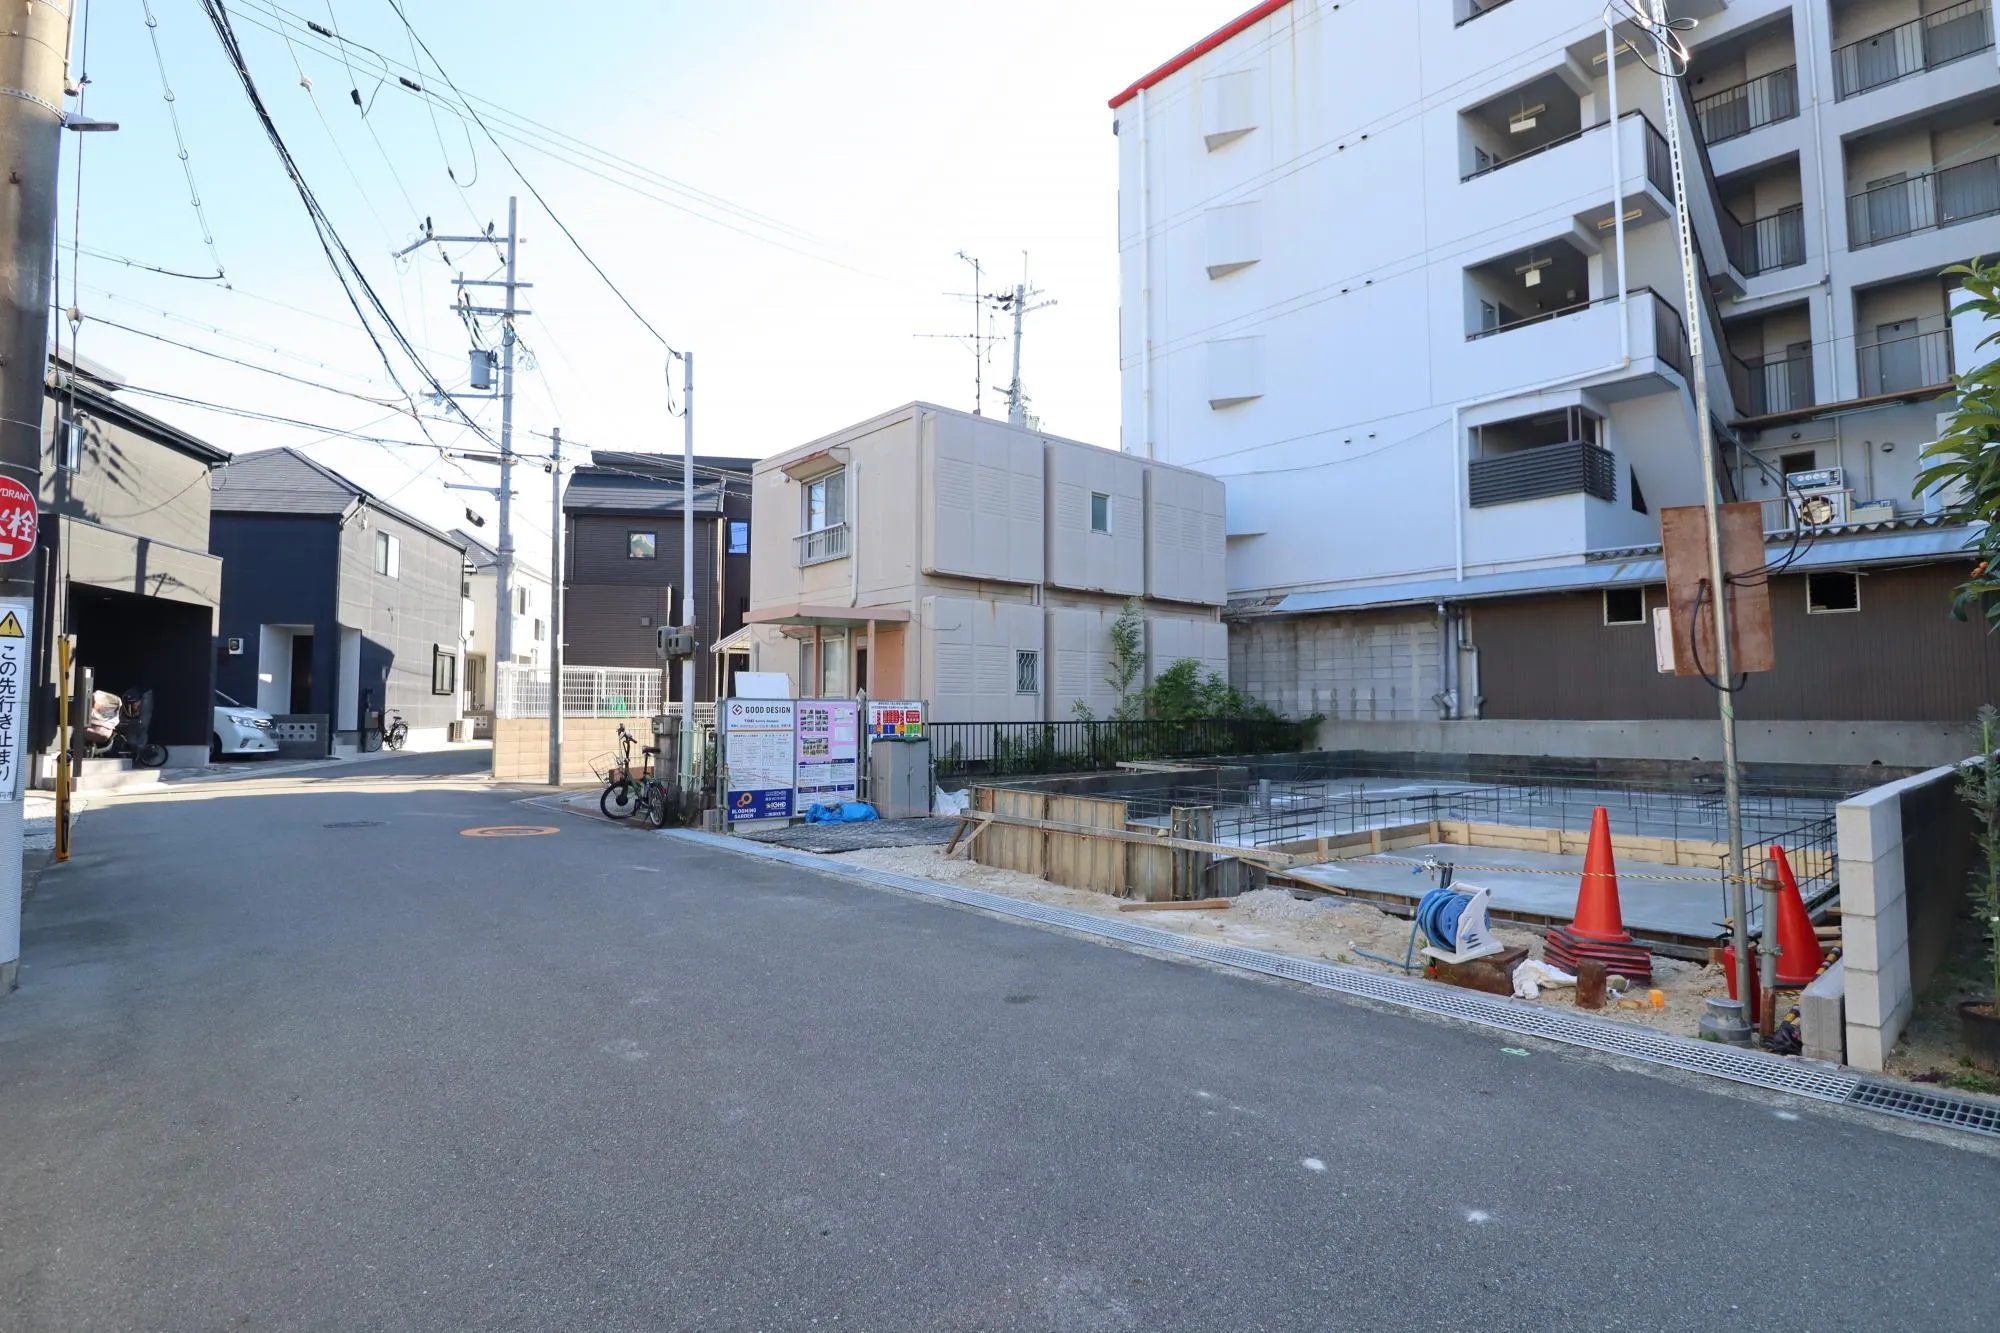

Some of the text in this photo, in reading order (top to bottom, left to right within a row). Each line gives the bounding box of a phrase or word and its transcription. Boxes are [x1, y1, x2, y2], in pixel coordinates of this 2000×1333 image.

[0, 645, 17, 781] この先行き止まり
[745, 706, 791, 714] GOOD DESIGN
